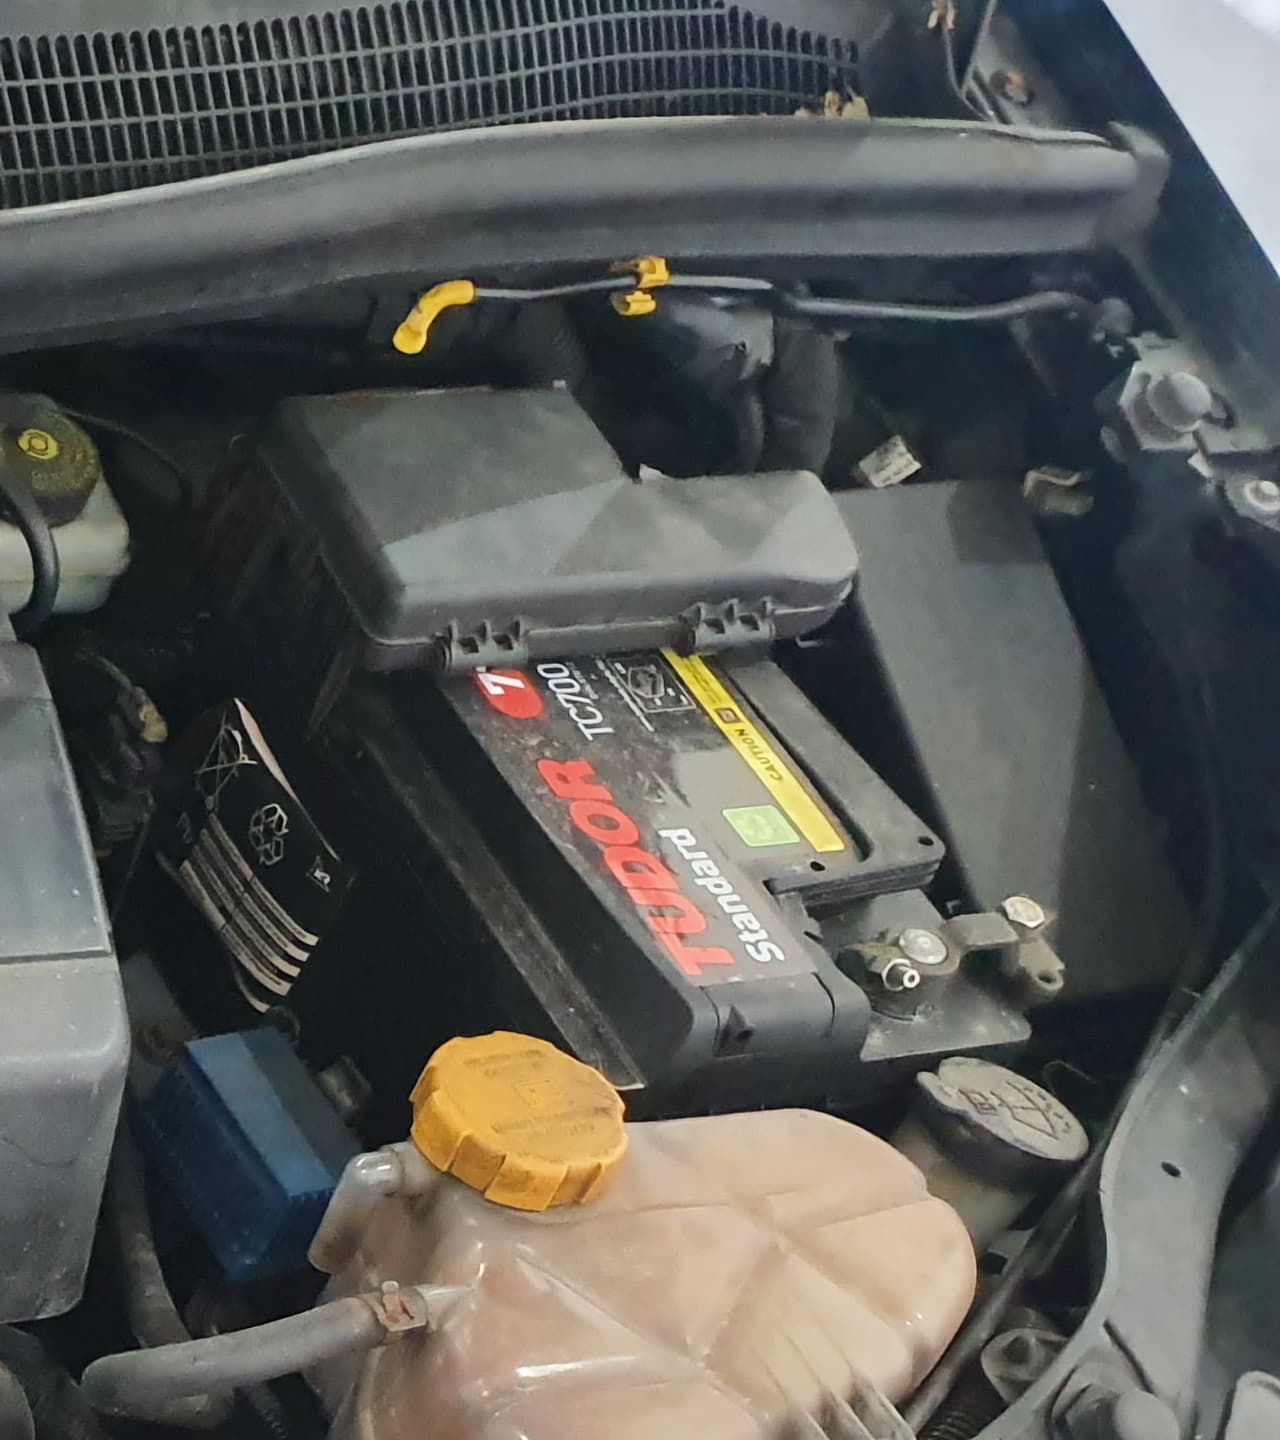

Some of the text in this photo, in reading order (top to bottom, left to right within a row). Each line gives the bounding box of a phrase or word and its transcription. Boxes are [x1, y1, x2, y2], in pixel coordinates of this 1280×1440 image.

[537, 663, 614, 741] TC700
[734, 728, 783, 781] CAUTION
[536, 758, 735, 976] TUDOR
[658, 828, 785, 962] Standard
